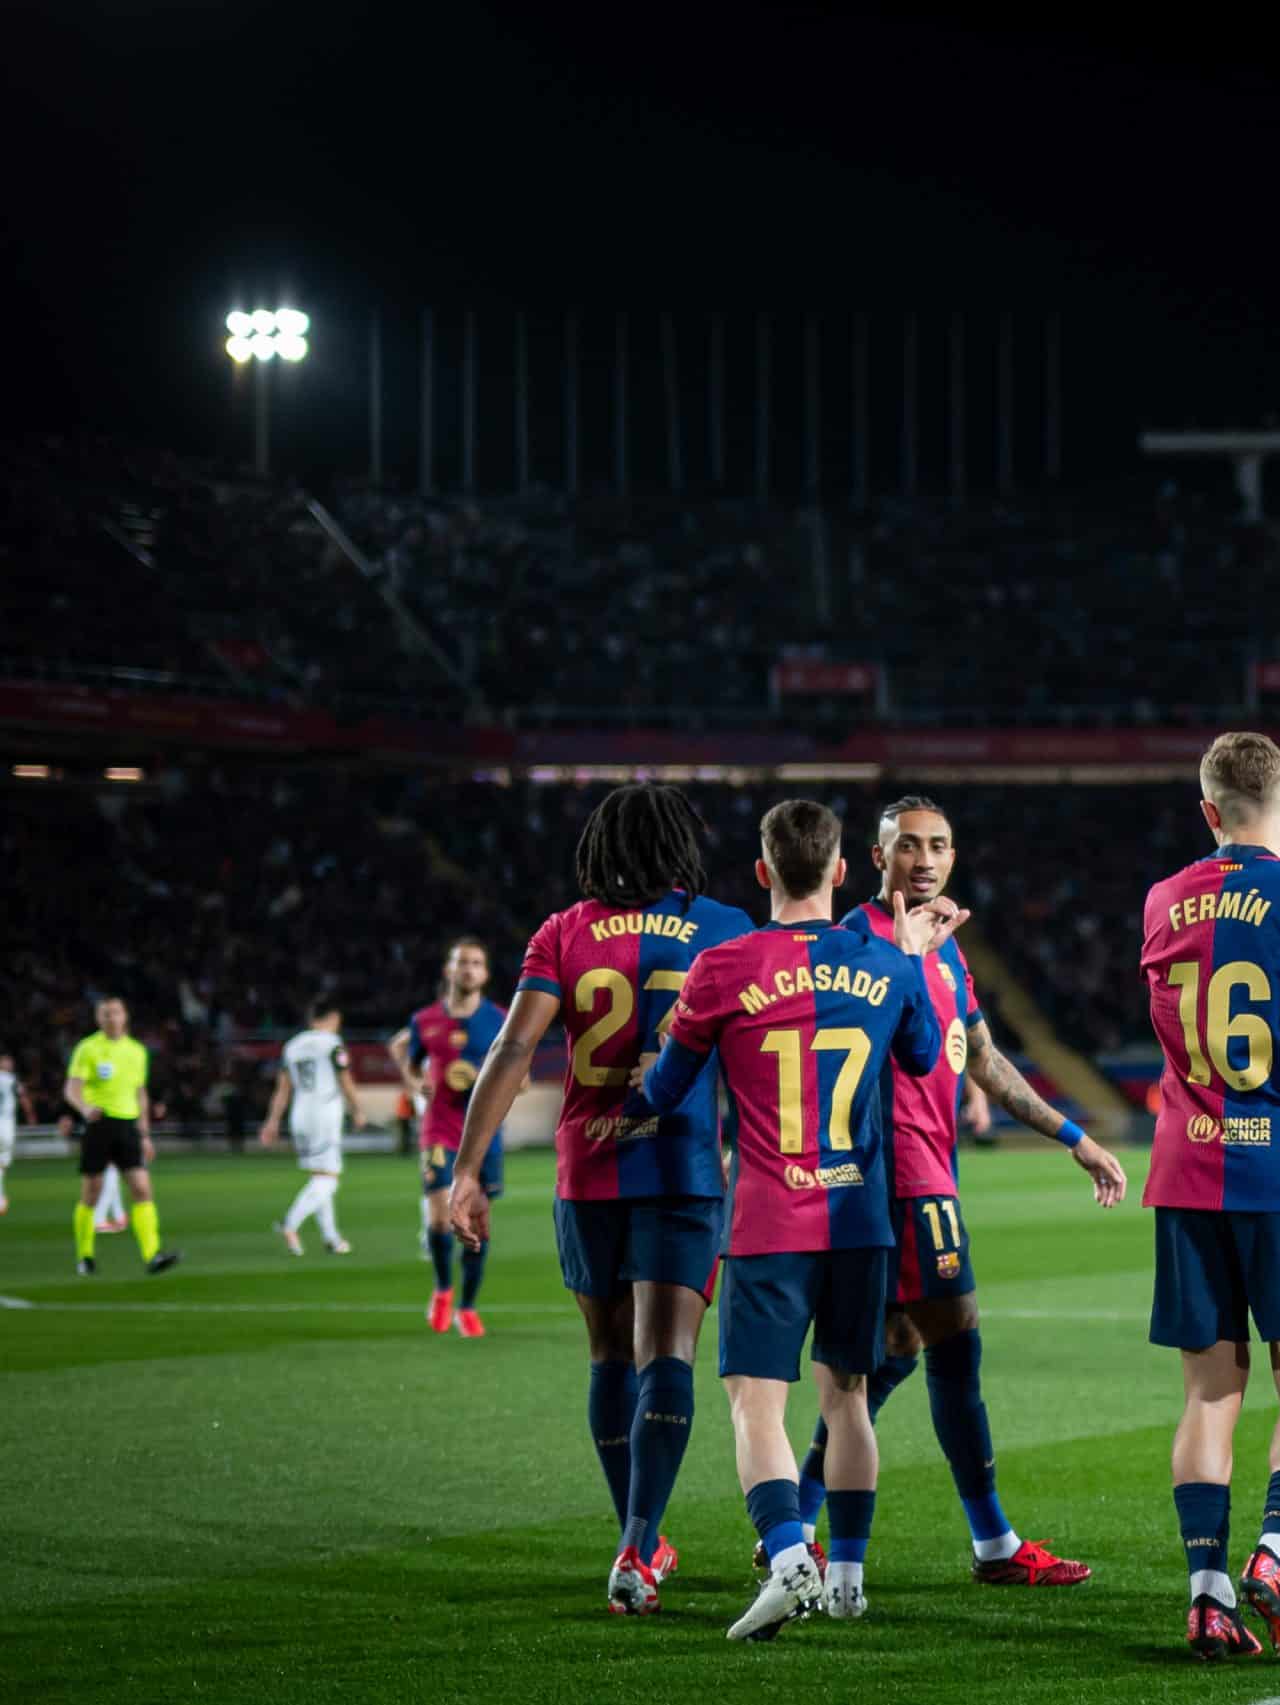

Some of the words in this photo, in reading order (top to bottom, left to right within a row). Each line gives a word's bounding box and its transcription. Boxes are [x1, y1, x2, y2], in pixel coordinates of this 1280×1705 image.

[590, 912, 698, 944] KOUNDE
[1168, 888, 1272, 932] FERMÍN
[1167, 960, 1273, 1092] 16
[760, 1027, 871, 1154] 17
[922, 1200, 961, 1250] 11
